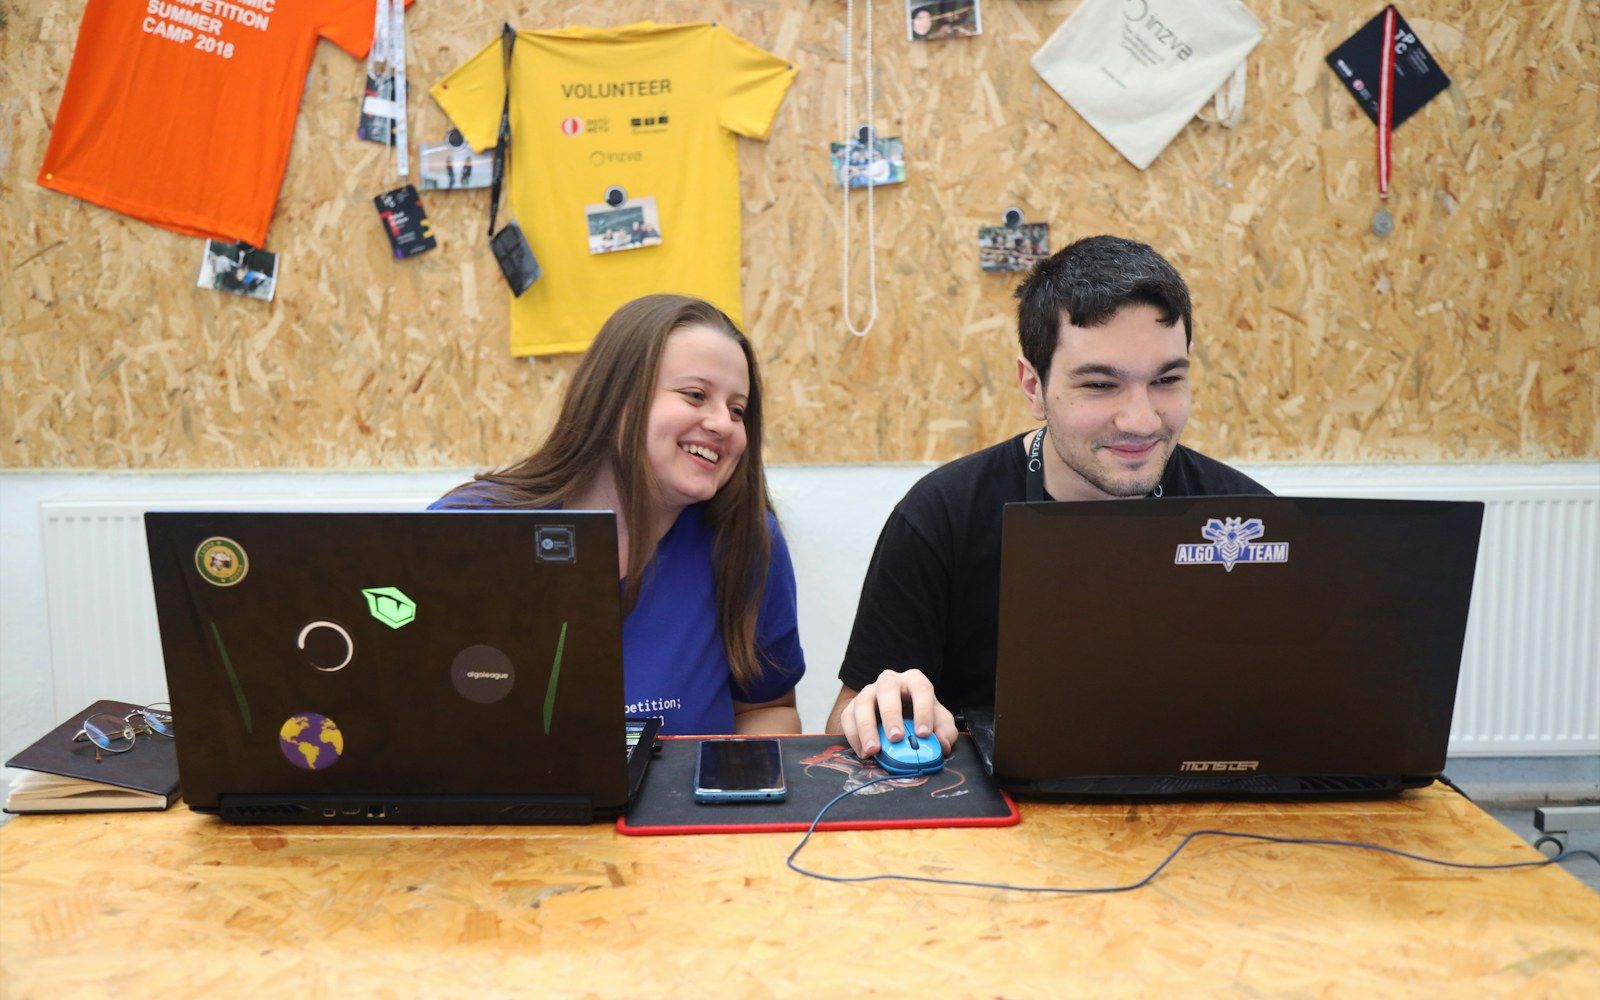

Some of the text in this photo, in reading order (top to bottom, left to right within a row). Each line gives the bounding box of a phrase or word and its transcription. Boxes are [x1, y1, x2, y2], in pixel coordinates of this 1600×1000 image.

[146, 0, 223, 36] SUMMER
[141, 16, 235, 59] CAMP 2018
[561, 79, 672, 99] VOLUNTEER
[1177, 544, 1286, 562] ALGO TEAM
[466, 671, 509, 680] algoleague
[1180, 761, 1259, 771] MONSTER
